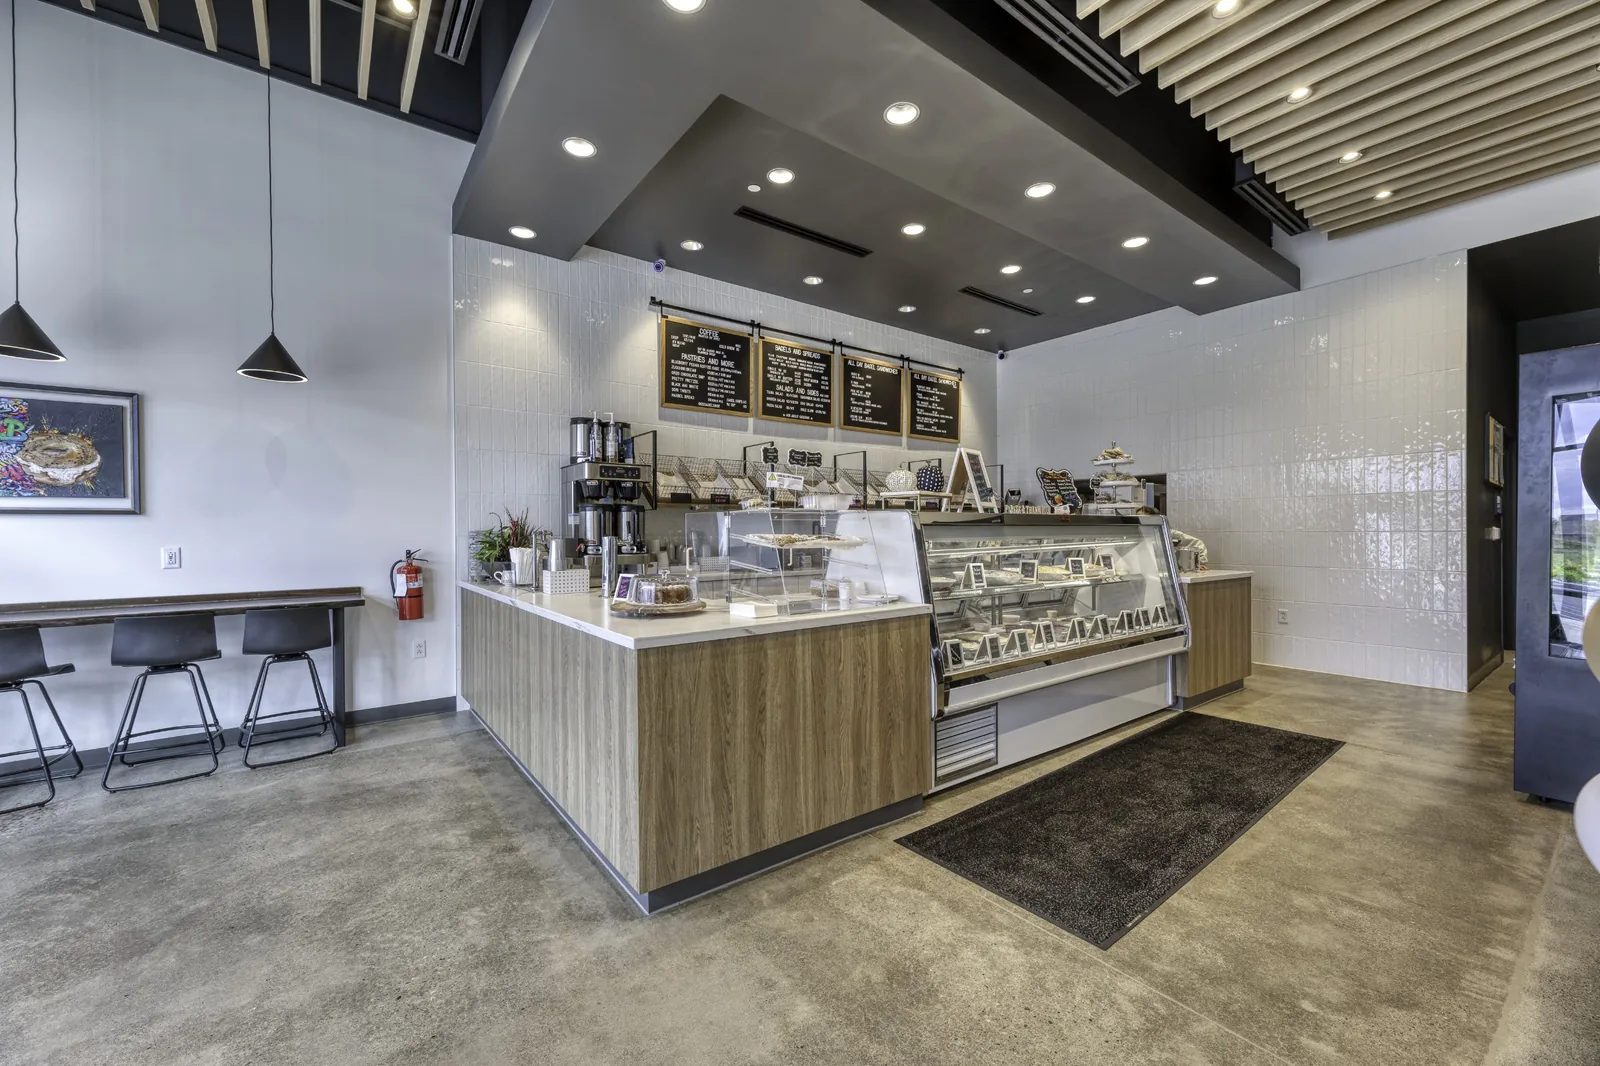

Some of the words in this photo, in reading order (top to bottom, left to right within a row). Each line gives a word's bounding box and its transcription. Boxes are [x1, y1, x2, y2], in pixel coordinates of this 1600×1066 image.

[699, 328, 720, 338] COFFEE
[775, 345, 791, 353] BAGELS
[803, 351, 820, 359] SPREADS
[681, 353, 705, 363] PASTRIES
[721, 360, 735, 368] MORE
[877, 366, 898, 374] SANDWICHES
[776, 384, 793, 392] SALADS
